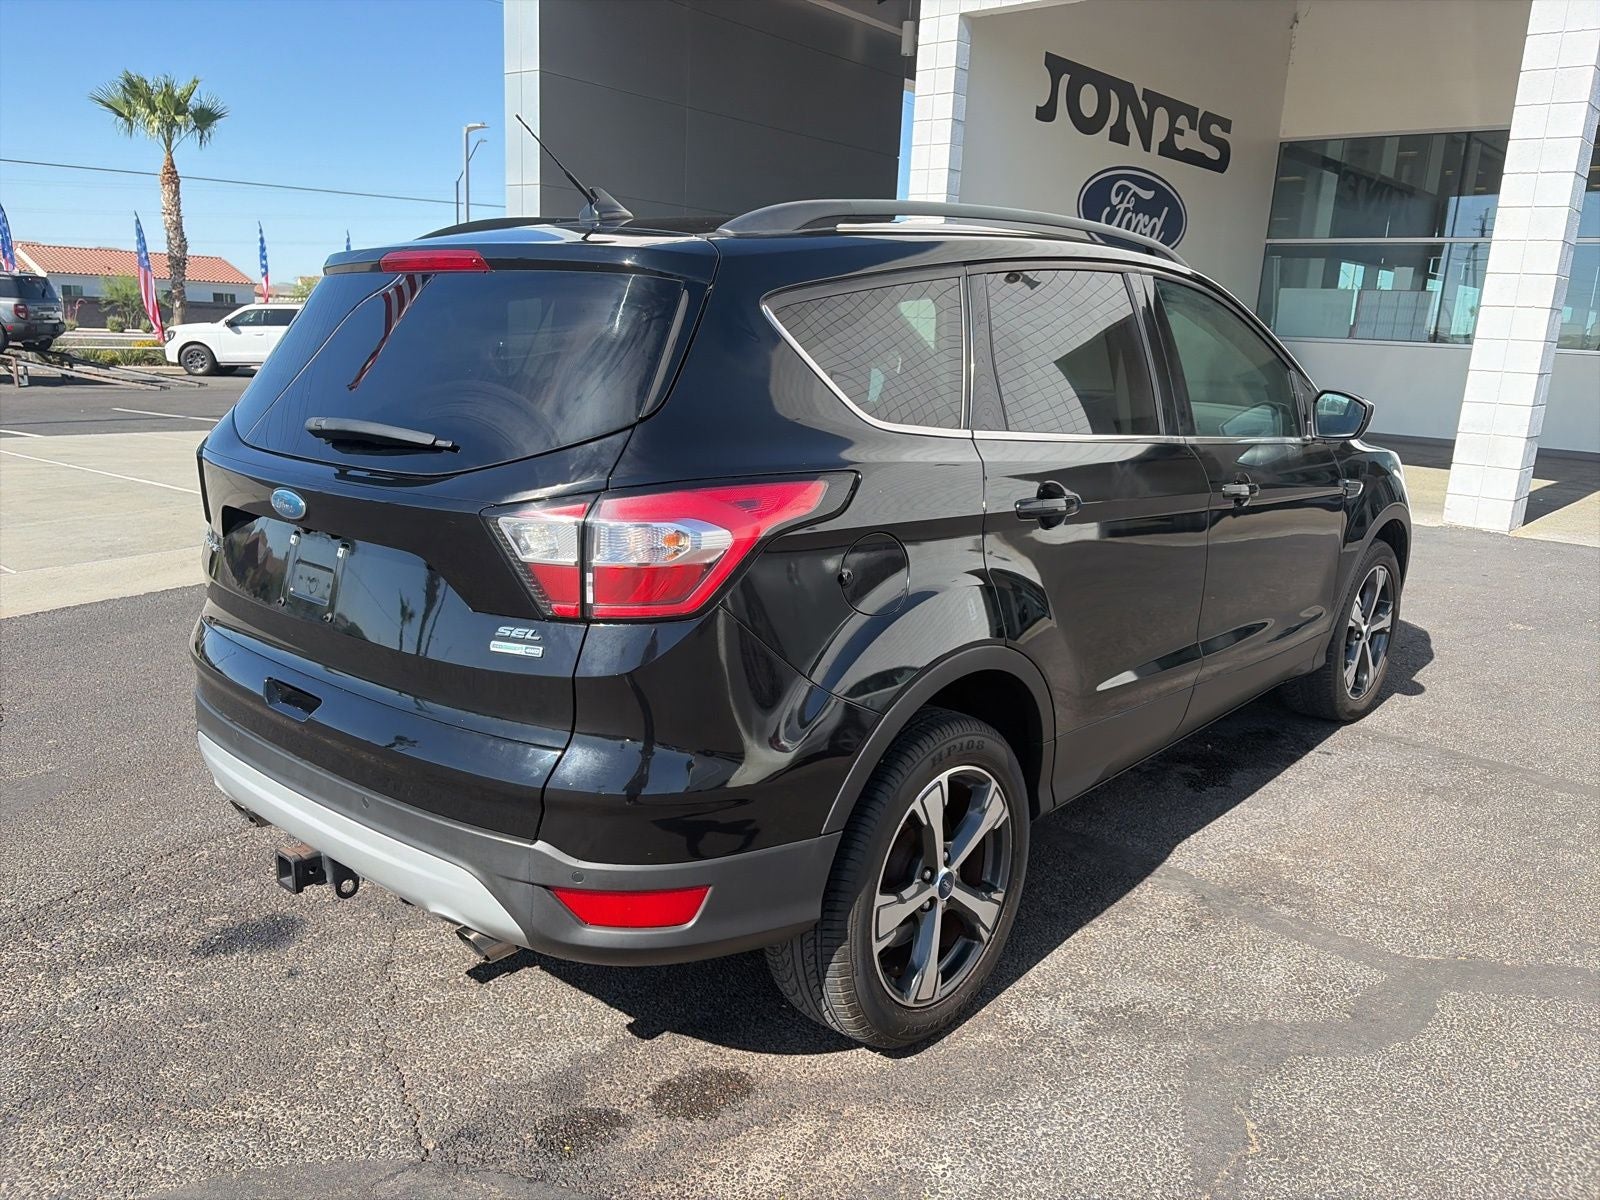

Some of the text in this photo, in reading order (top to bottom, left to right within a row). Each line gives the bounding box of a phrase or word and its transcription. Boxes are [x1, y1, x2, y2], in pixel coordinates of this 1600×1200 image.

[1035, 51, 1232, 174] JONES
[1101, 180, 1169, 241] Ford
[495, 626, 541, 640] SEL
[931, 740, 985, 769] HP108
